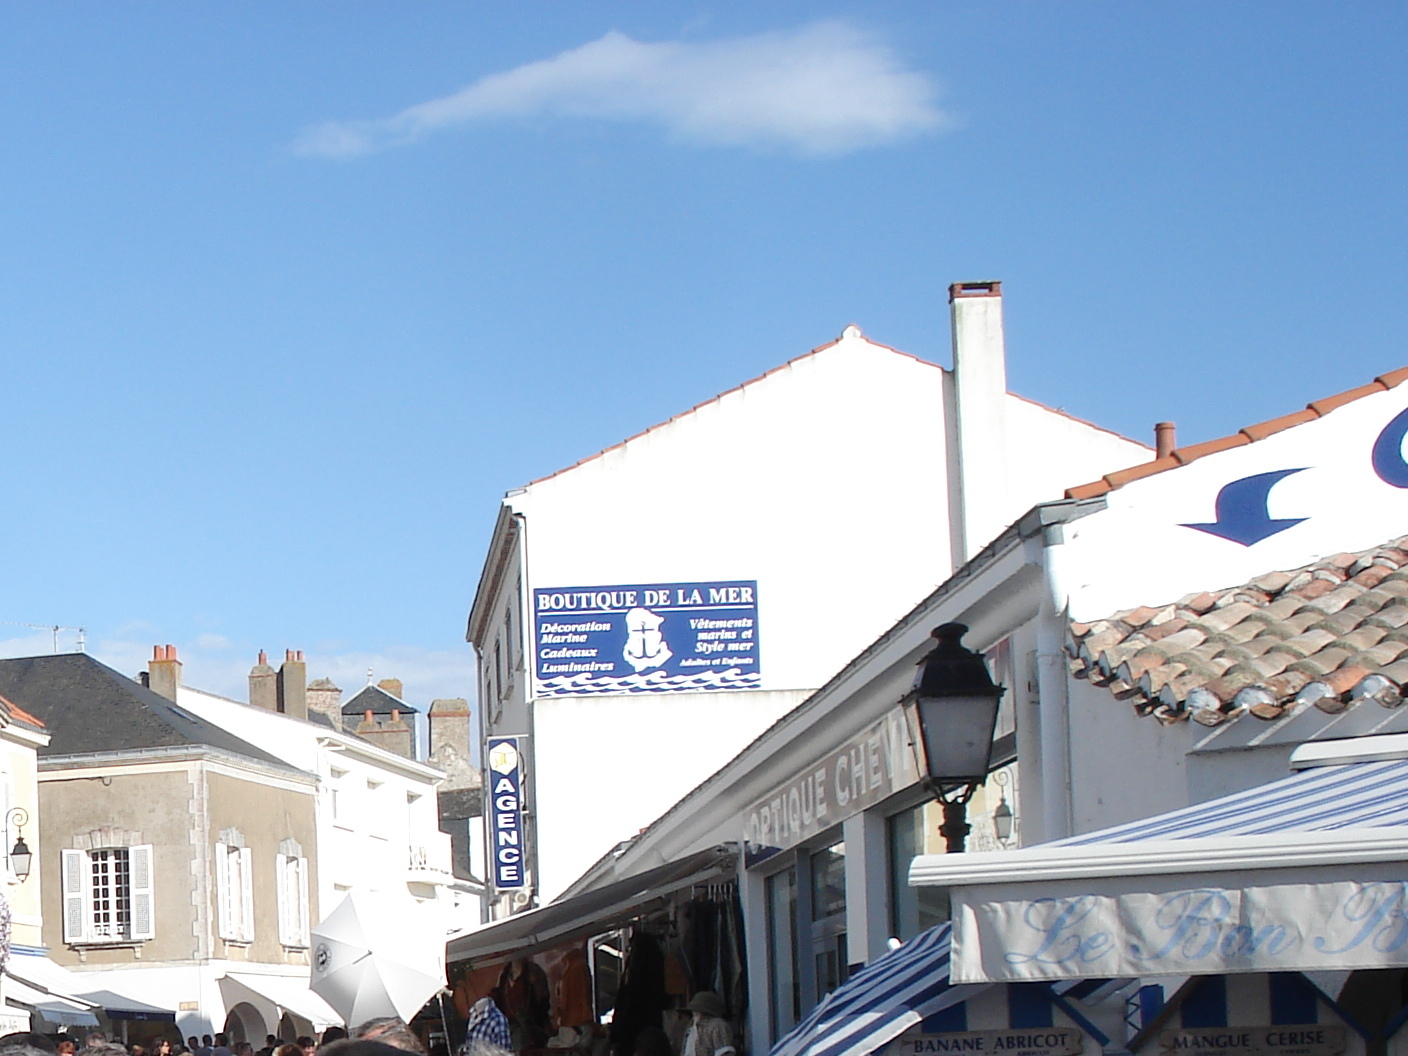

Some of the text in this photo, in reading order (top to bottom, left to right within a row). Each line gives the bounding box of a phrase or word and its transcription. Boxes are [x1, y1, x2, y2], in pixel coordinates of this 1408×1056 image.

[538, 587, 754, 610] BOUTIQUE DE LA MER
[540, 621, 611, 633] Décoration
[689, 618, 753, 630] Vêtements
[540, 633, 587, 644] Marine
[698, 629, 753, 640] marins et
[540, 648, 598, 659] Cadeaux
[695, 641, 754, 655] Style mer
[542, 662, 614, 673] Luminaires
[749, 767, 827, 854] OPTIQUE
[494, 778, 520, 881] AGENCE
[1004, 880, 1408, 964] Le Bon B
[914, 1034, 1068, 1053] BANANE ABRICOT
[1173, 1031, 1325, 1049] MANGUE CERISE
